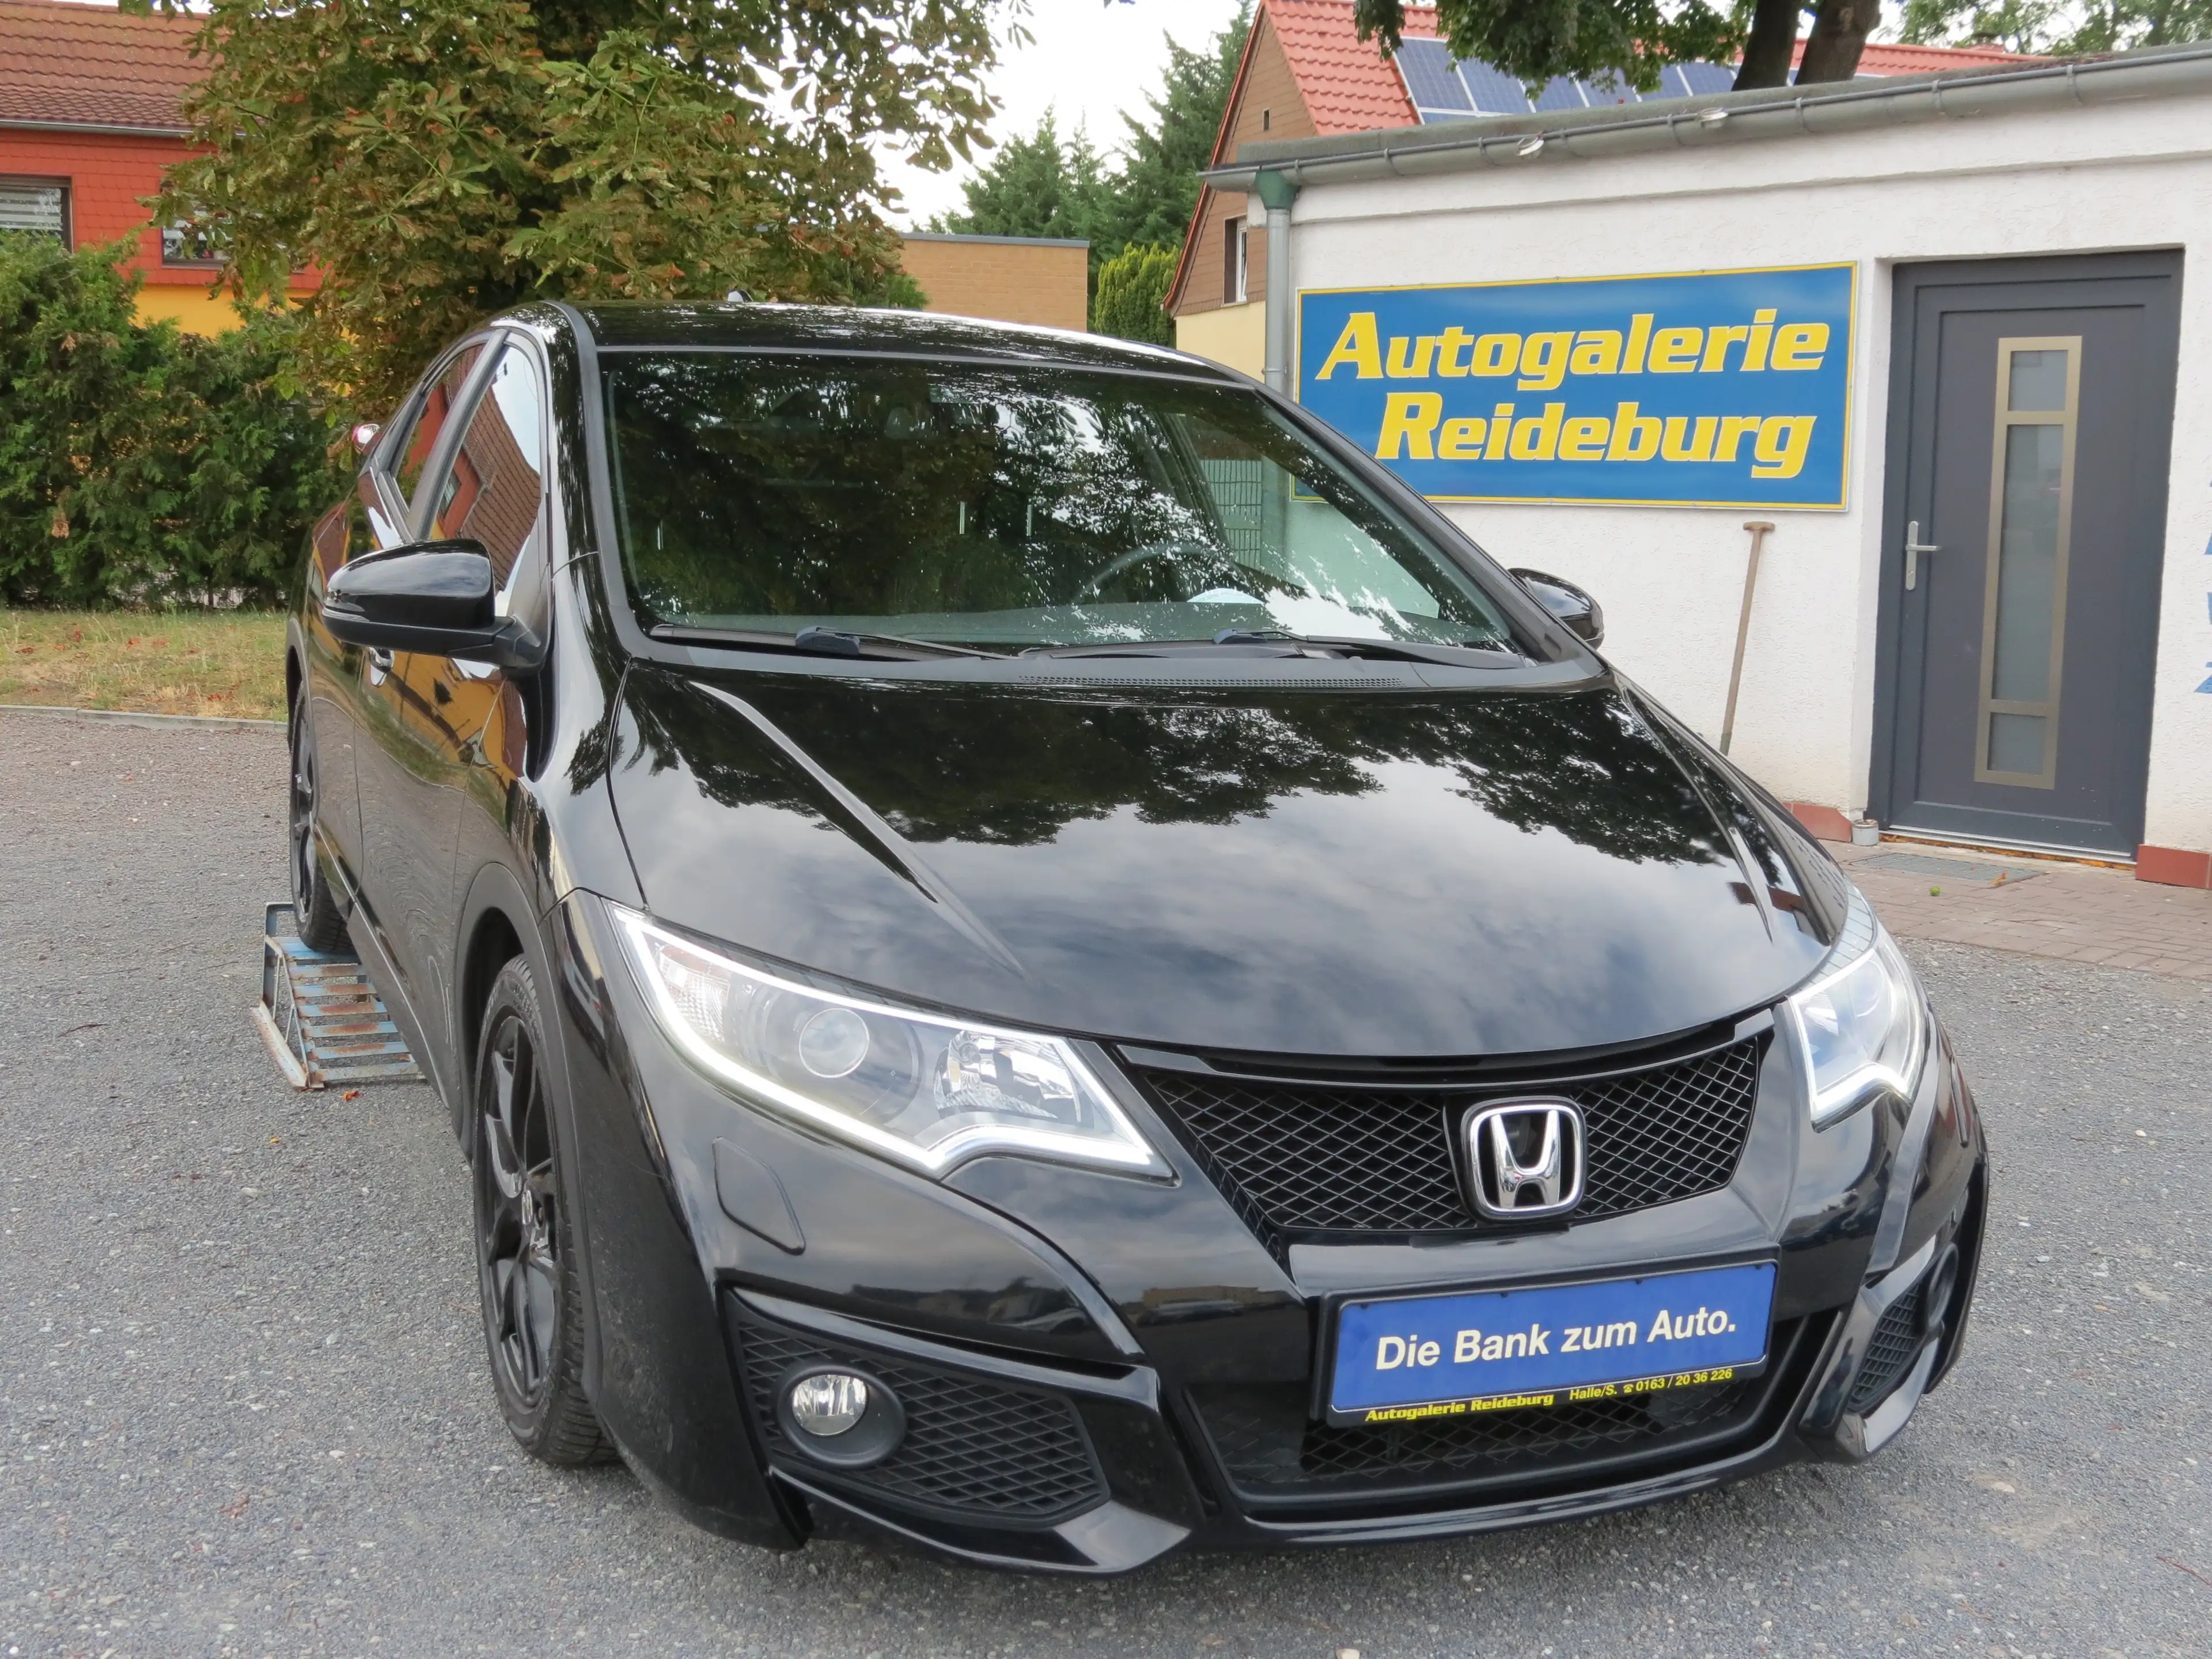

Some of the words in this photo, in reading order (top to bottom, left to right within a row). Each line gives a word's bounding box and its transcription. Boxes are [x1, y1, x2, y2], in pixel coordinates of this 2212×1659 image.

[1315, 309, 1830, 391] Autogalerie
[1375, 392, 1817, 478] Reideburg
[1374, 1334, 1441, 1371] Die
[1453, 1322, 1551, 1365] Bank
[1559, 1320, 1638, 1353] zum
[1646, 1305, 1737, 1343] Auto.
[1365, 1402, 1467, 1422] Autogalerie
[1470, 1393, 1555, 1412] Reideburg
[1569, 1384, 1618, 1400] Halle/S.
[1635, 1377, 1666, 1392] 0163
[1675, 1373, 1691, 1387] 20
[1692, 1371, 1708, 1384] 36
[1710, 1368, 1733, 1382] 226
